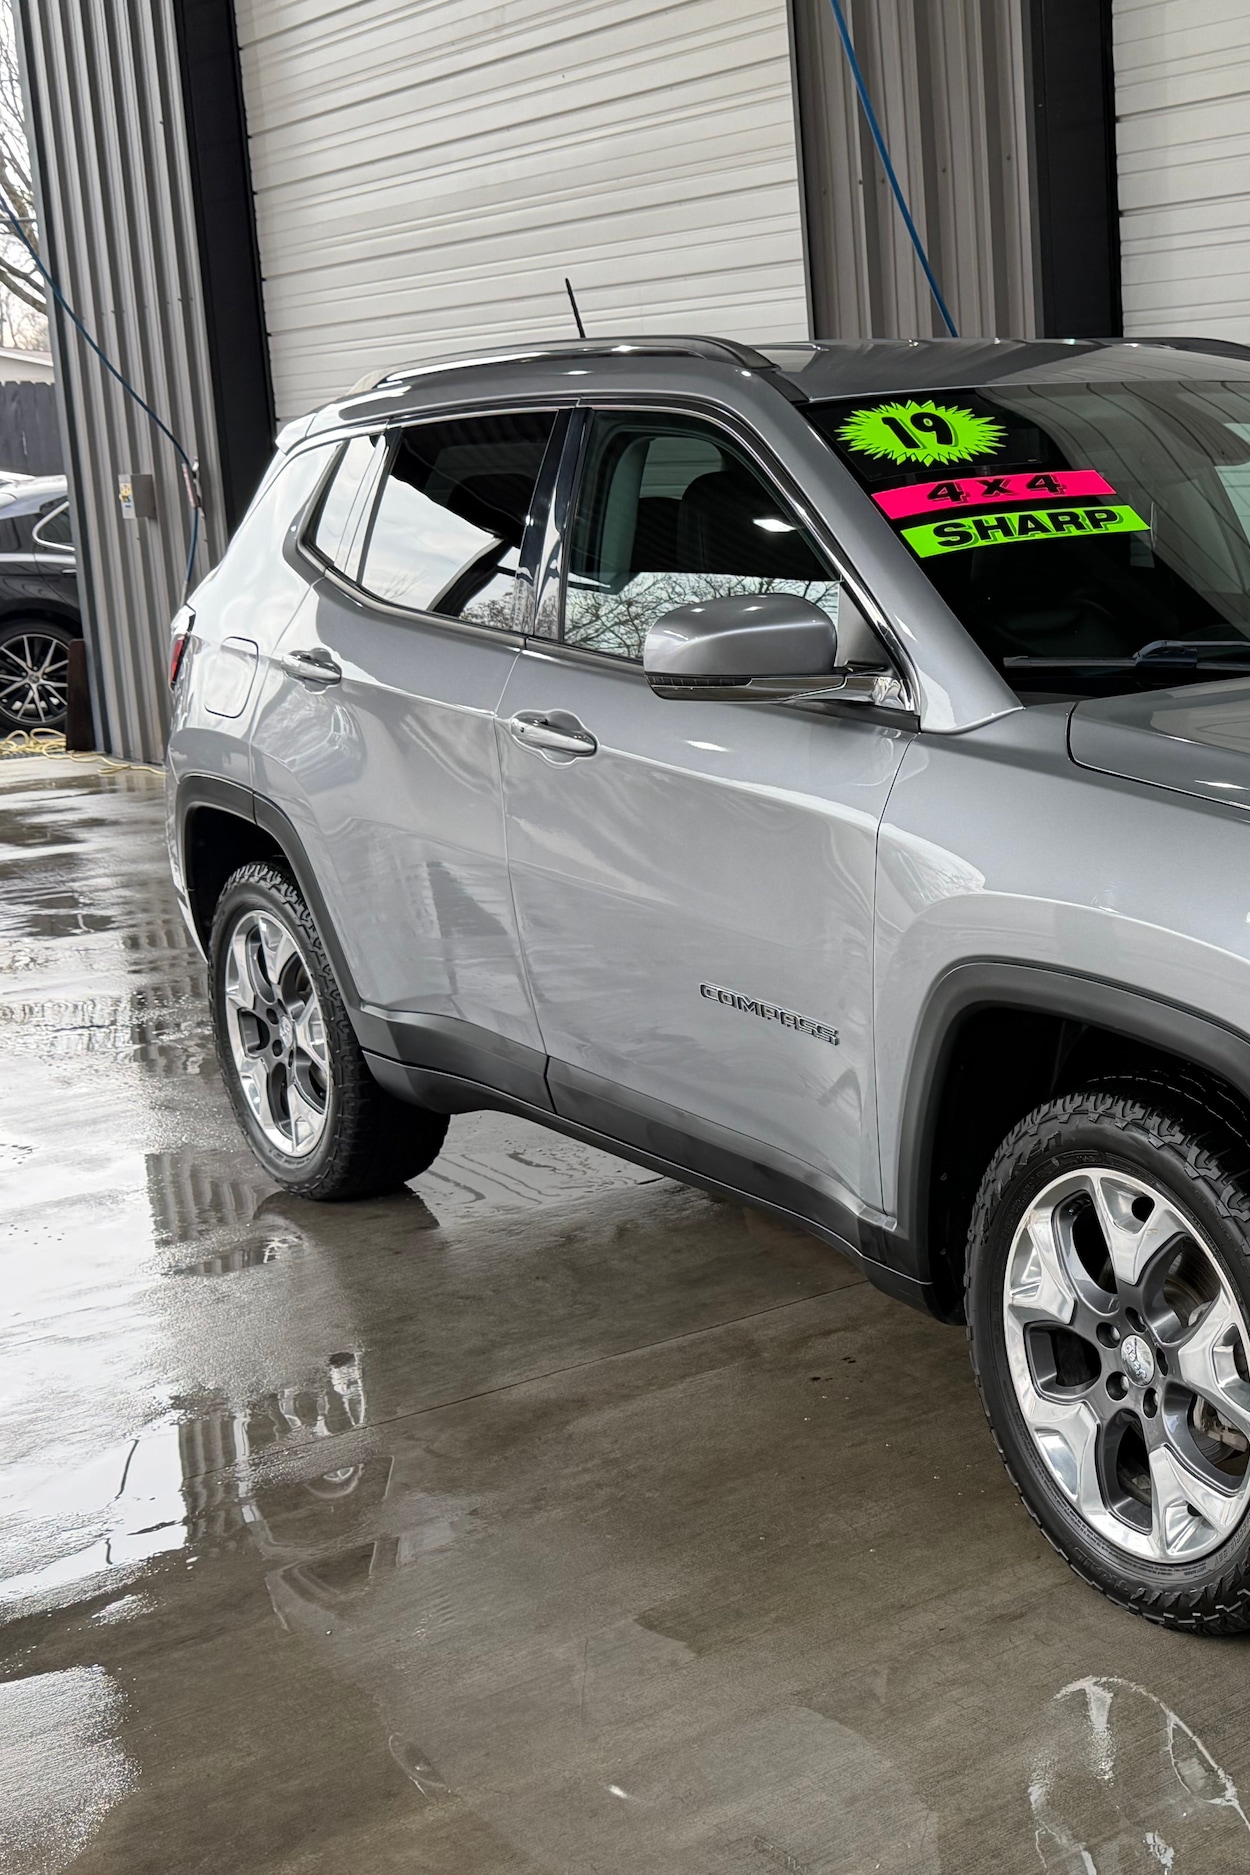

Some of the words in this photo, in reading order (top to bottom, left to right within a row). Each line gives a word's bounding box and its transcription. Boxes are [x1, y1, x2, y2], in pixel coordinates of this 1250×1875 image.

[881, 411, 957, 449] 19
[932, 509, 1122, 548] SHARP
[699, 981, 841, 1046] COMPASS
